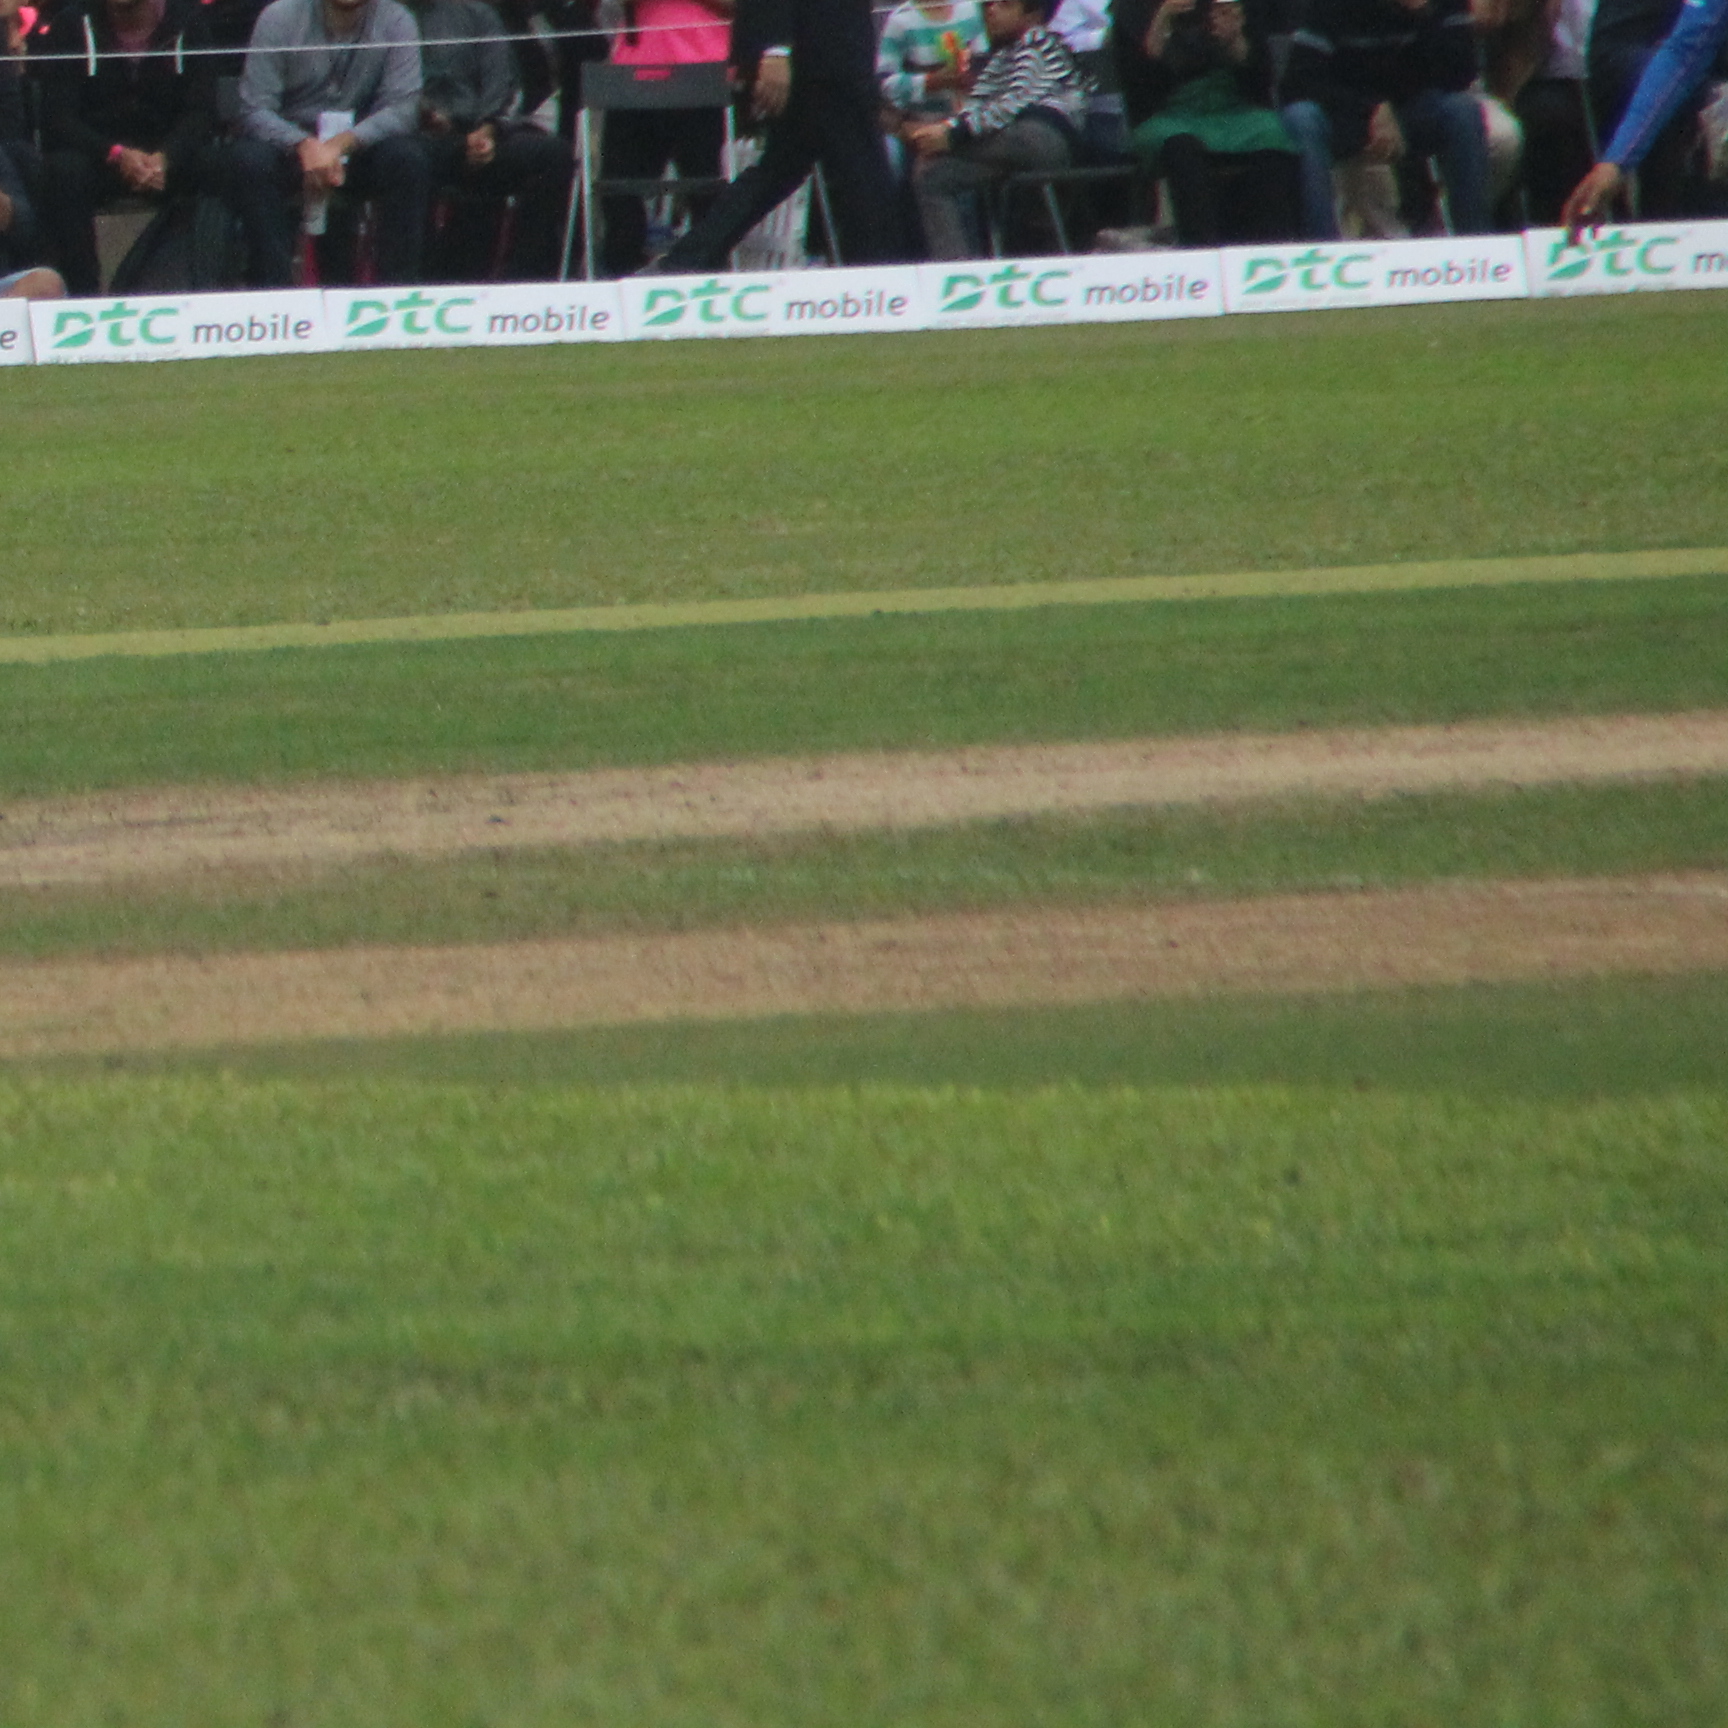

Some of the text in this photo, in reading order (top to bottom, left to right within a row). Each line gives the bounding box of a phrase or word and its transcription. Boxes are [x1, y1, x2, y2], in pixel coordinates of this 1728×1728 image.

[1083, 273, 1211, 308] mobile
[1386, 257, 1512, 291] mobile
[488, 300, 611, 335] mobile
[785, 286, 910, 321] mobile
[190, 312, 314, 346] mobile
